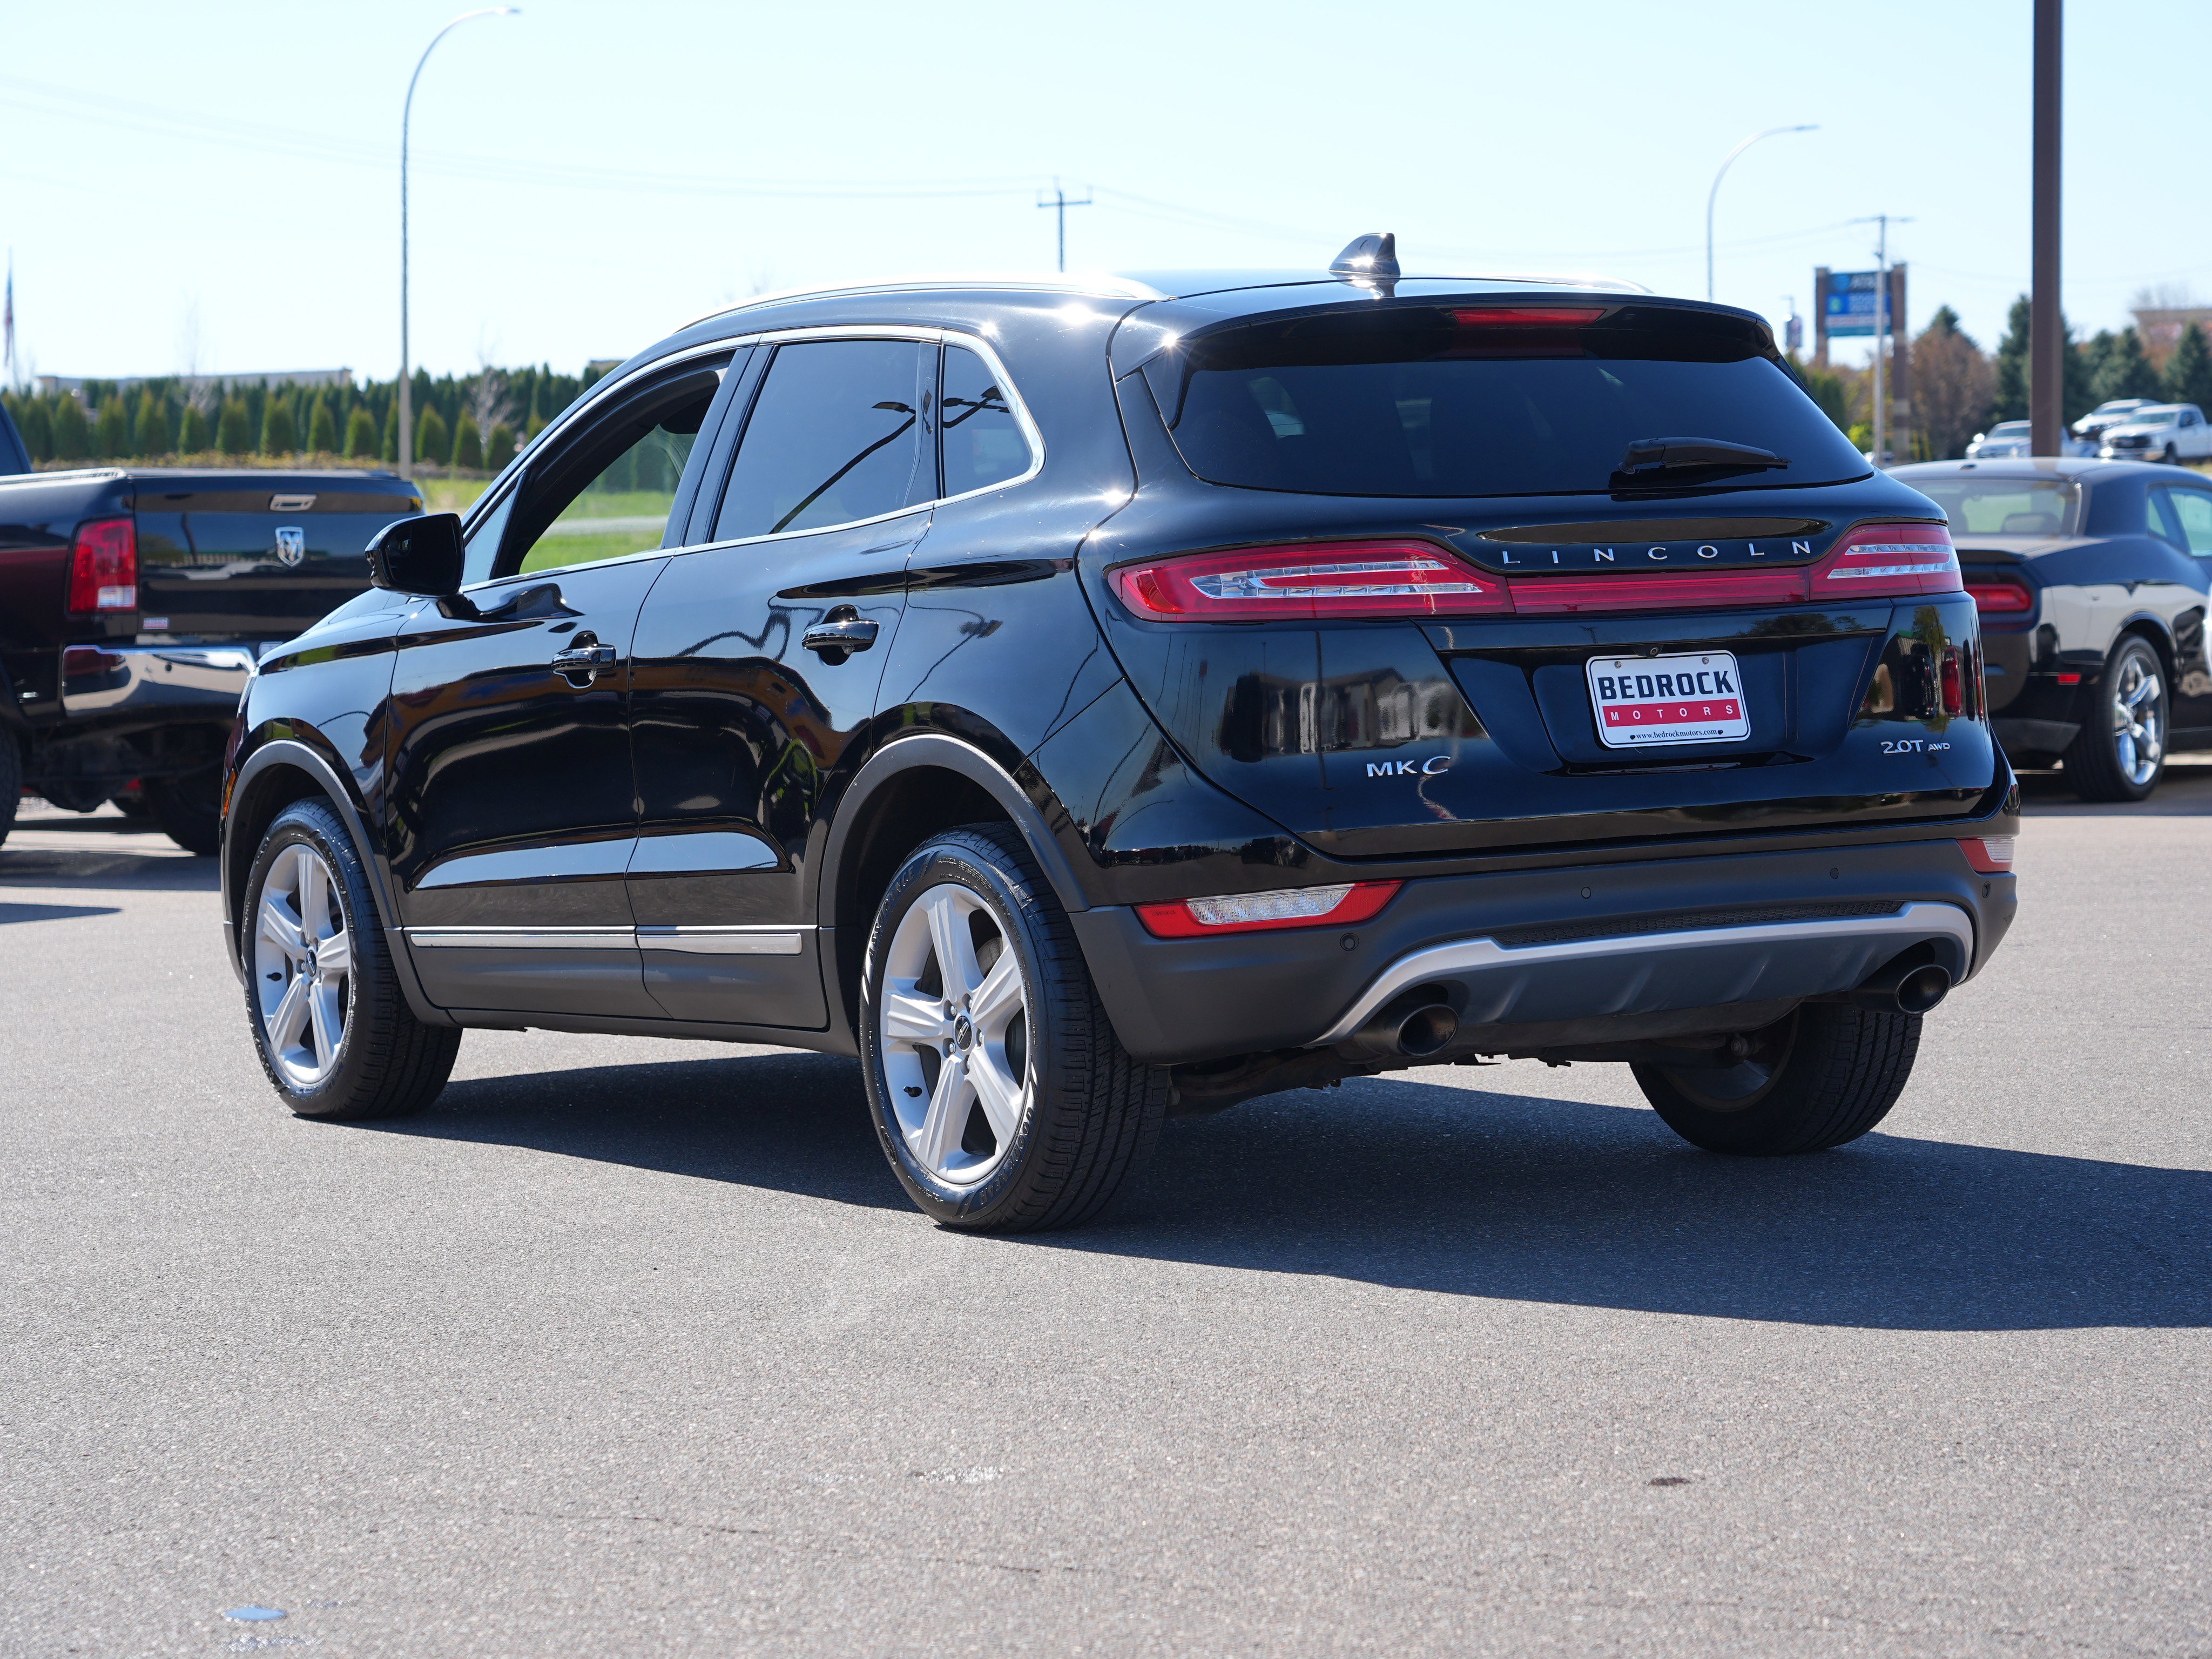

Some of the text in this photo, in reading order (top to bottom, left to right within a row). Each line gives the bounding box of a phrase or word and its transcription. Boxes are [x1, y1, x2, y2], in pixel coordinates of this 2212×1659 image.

[1502, 540, 1811, 564] LINCOLN
[1597, 671, 1735, 700] BEDROCK
[1610, 705, 1734, 721] MOTORS
[1636, 729, 1717, 739] www.bedrockmotors.com
[1927, 743, 1951, 751] AWD
[1366, 756, 1451, 777] MKC
